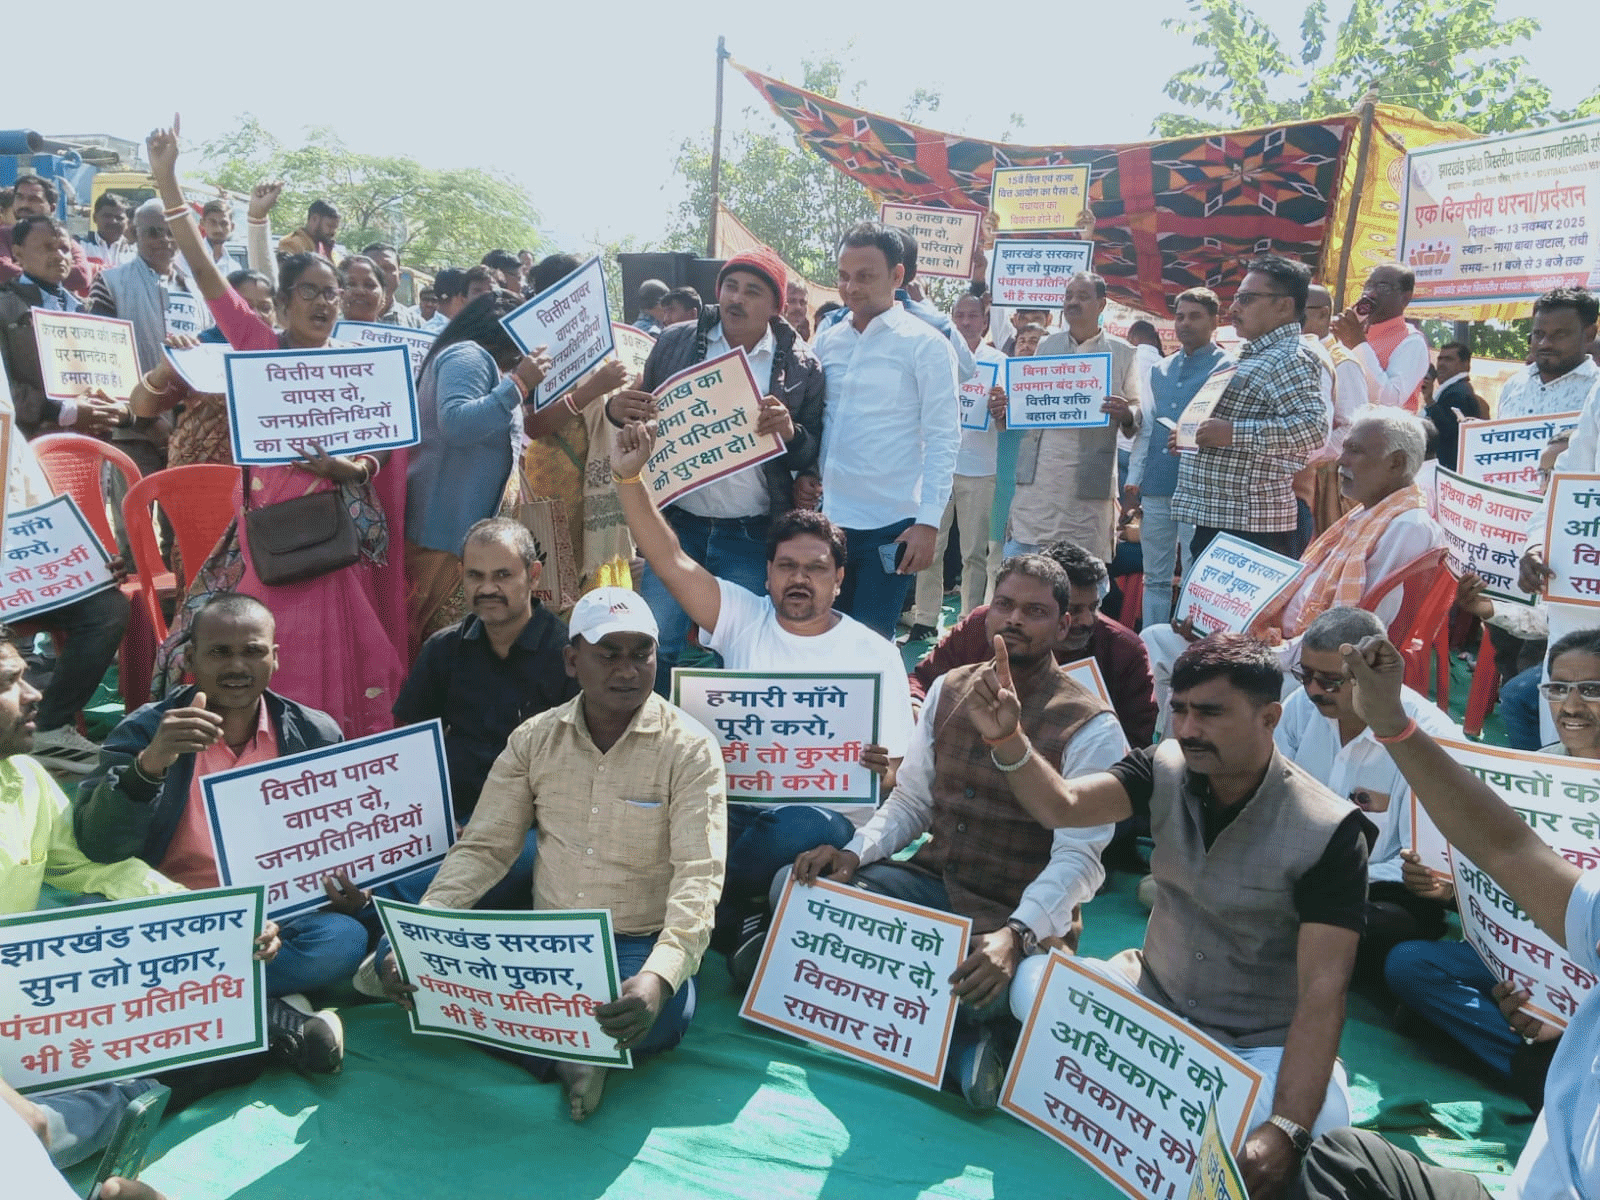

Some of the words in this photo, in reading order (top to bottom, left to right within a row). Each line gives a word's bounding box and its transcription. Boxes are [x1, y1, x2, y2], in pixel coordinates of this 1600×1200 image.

[895, 212, 912, 222] 30
[916, 213, 943, 225] लाख
[947, 214, 962, 226] का
[1415, 203, 1439, 228] एक
[1440, 193, 1494, 223] दिवसीय
[1507, 224, 1518, 234] 13
[1522, 220, 1553, 232] नवम्बर
[1556, 216, 1585, 230] 2025
[921, 241, 964, 255] परिवारों
[1001, 248, 1043, 259] झारखंड
[1045, 250, 1085, 259] सरकार
[1006, 264, 1024, 275] सुन
[1027, 261, 1041, 272] लो
[1492, 262, 1502, 271] 11
[1505, 257, 1521, 270] बजे
[1524, 256, 1533, 269] से
[1535, 259, 1542, 268] 3
[1545, 254, 1563, 266] बजे
[1565, 256, 1584, 266] तक
[998, 277, 1034, 287] पंचायत
[1003, 289, 1016, 300] भी
[536, 297, 571, 328] वित्तीय
[570, 281, 591, 304] पावर
[69, 326, 95, 339] राज्य
[361, 329, 405, 343] वित्तीय
[556, 316, 579, 341] वापस
[55, 349, 70, 362] पर
[1023, 364, 1048, 376] बिना
[1079, 361, 1092, 373] के
[60, 371, 92, 385] हमारा
[265, 362, 325, 382] वित्तीय
[328, 362, 375, 378] पावर
[544, 376, 557, 393] का
[559, 352, 586, 382] सम्मान
[1012, 382, 1053, 392] अपमान
[1055, 380, 1072, 390] बंद
[1076, 376, 1102, 390] करो,
[281, 388, 335, 405] वापस
[339, 382, 366, 402] दो,
[656, 381, 694, 412] लाख
[695, 369, 724, 388] का
[1025, 394, 1060, 407] वित्तीय
[1063, 392, 1092, 405] शक्ति
[258, 401, 392, 429] जनप्रतिनिधियों
[655, 410, 687, 438] बीमा
[688, 398, 718, 417] दो,
[1025, 410, 1056, 421] बहाल
[254, 438, 281, 453] का
[285, 430, 350, 451] सम्मान
[647, 440, 678, 472] हमारे
[679, 407, 748, 446] परिवारों
[1480, 422, 1555, 444] पंचायतों
[652, 470, 671, 491] को
[671, 446, 725, 480] सुरक्षा
[1474, 449, 1541, 465] सम्मान
[1440, 481, 1466, 506] मुखिया
[1467, 493, 1483, 511] की
[1462, 517, 1478, 533] का
[4, 540, 59, 560] करो,
[5, 566, 33, 583] तो
[33, 544, 90, 580] कुर्सी
[1467, 542, 1489, 562] पूरी
[1492, 550, 1519, 568] करे
[1201, 565, 1221, 582] सुन
[1219, 570, 1235, 585] लो
[1210, 546, 1252, 568] झारखंड
[1248, 561, 1288, 583] सरकार
[1212, 593, 1253, 619] प्रतिनिधि
[705, 685, 787, 708] हमारी
[792, 685, 849, 708] माँगे
[714, 714, 765, 741] पूरी
[771, 714, 835, 739] करो,
[755, 742, 789, 764] तो
[794, 741, 863, 769] कुर्सी
[260, 769, 338, 806] वित्तीय
[341, 753, 400, 782] पावर
[283, 797, 354, 830] वापस
[357, 785, 390, 810] दो,
[255, 803, 423, 870] जनप्रतिनिधियों
[0, 925, 134, 967] झारखंड
[139, 908, 248, 943] सरकार
[397, 920, 491, 951] झारखंड
[496, 933, 594, 954] सरकार
[807, 899, 908, 945] पंचायतों
[911, 928, 945, 956] को
[1468, 894, 1555, 970] विकास
[19, 971, 82, 1007] सुन
[89, 957, 132, 989] लो
[138, 947, 226, 989] पुकार,
[420, 951, 462, 976] सुन
[464, 957, 497, 981] लो
[501, 965, 583, 991] पुकार,
[791, 930, 905, 980] अधिकार
[908, 961, 939, 997] दो,
[417, 974, 493, 1007] पंचायत
[497, 990, 603, 1018] प्रतिनिधि
[793, 958, 890, 1011] विकास
[893, 996, 930, 1025] को
[0, 1003, 116, 1041] पंचायत
[122, 974, 245, 1023] प्रतिनिधि
[440, 1003, 469, 1026] भी
[469, 1008, 487, 1031] हैं
[783, 994, 869, 1041] रफ़्तार
[21, 1044, 63, 1074] भी
[69, 1038, 95, 1069] हैं
[1068, 986, 1185, 1071] पंचायतों
[1187, 1058, 1228, 1102] को
[1050, 1021, 1177, 1111] अधिकार
[1044, 1092, 1133, 1167] रफ़्तार
[1053, 1056, 1157, 1142] विकास
[1159, 1129, 1198, 1175] को
